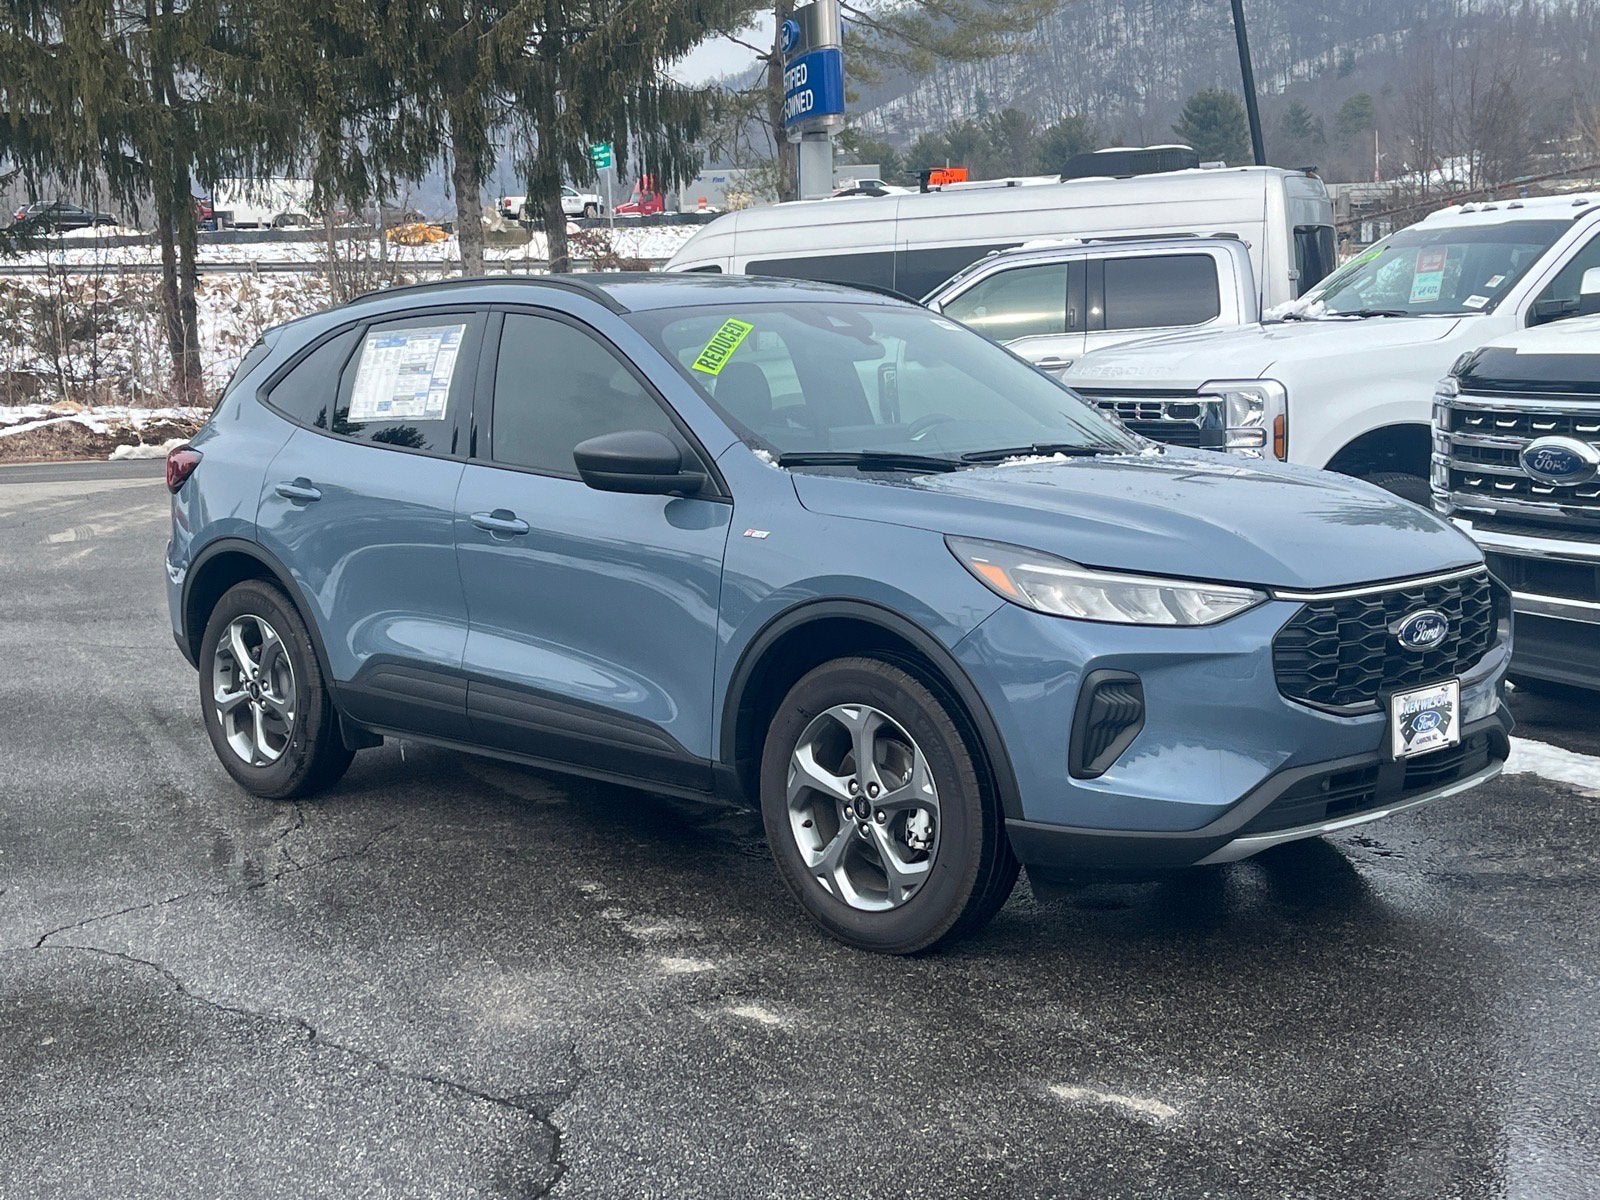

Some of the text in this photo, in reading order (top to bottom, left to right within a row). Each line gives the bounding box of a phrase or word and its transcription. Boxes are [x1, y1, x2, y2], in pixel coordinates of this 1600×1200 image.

[697, 322, 746, 371] REDUCED
[1534, 449, 1571, 471] Ford
[1413, 619, 1440, 643] Ford
[1418, 714, 1436, 731] Ford
